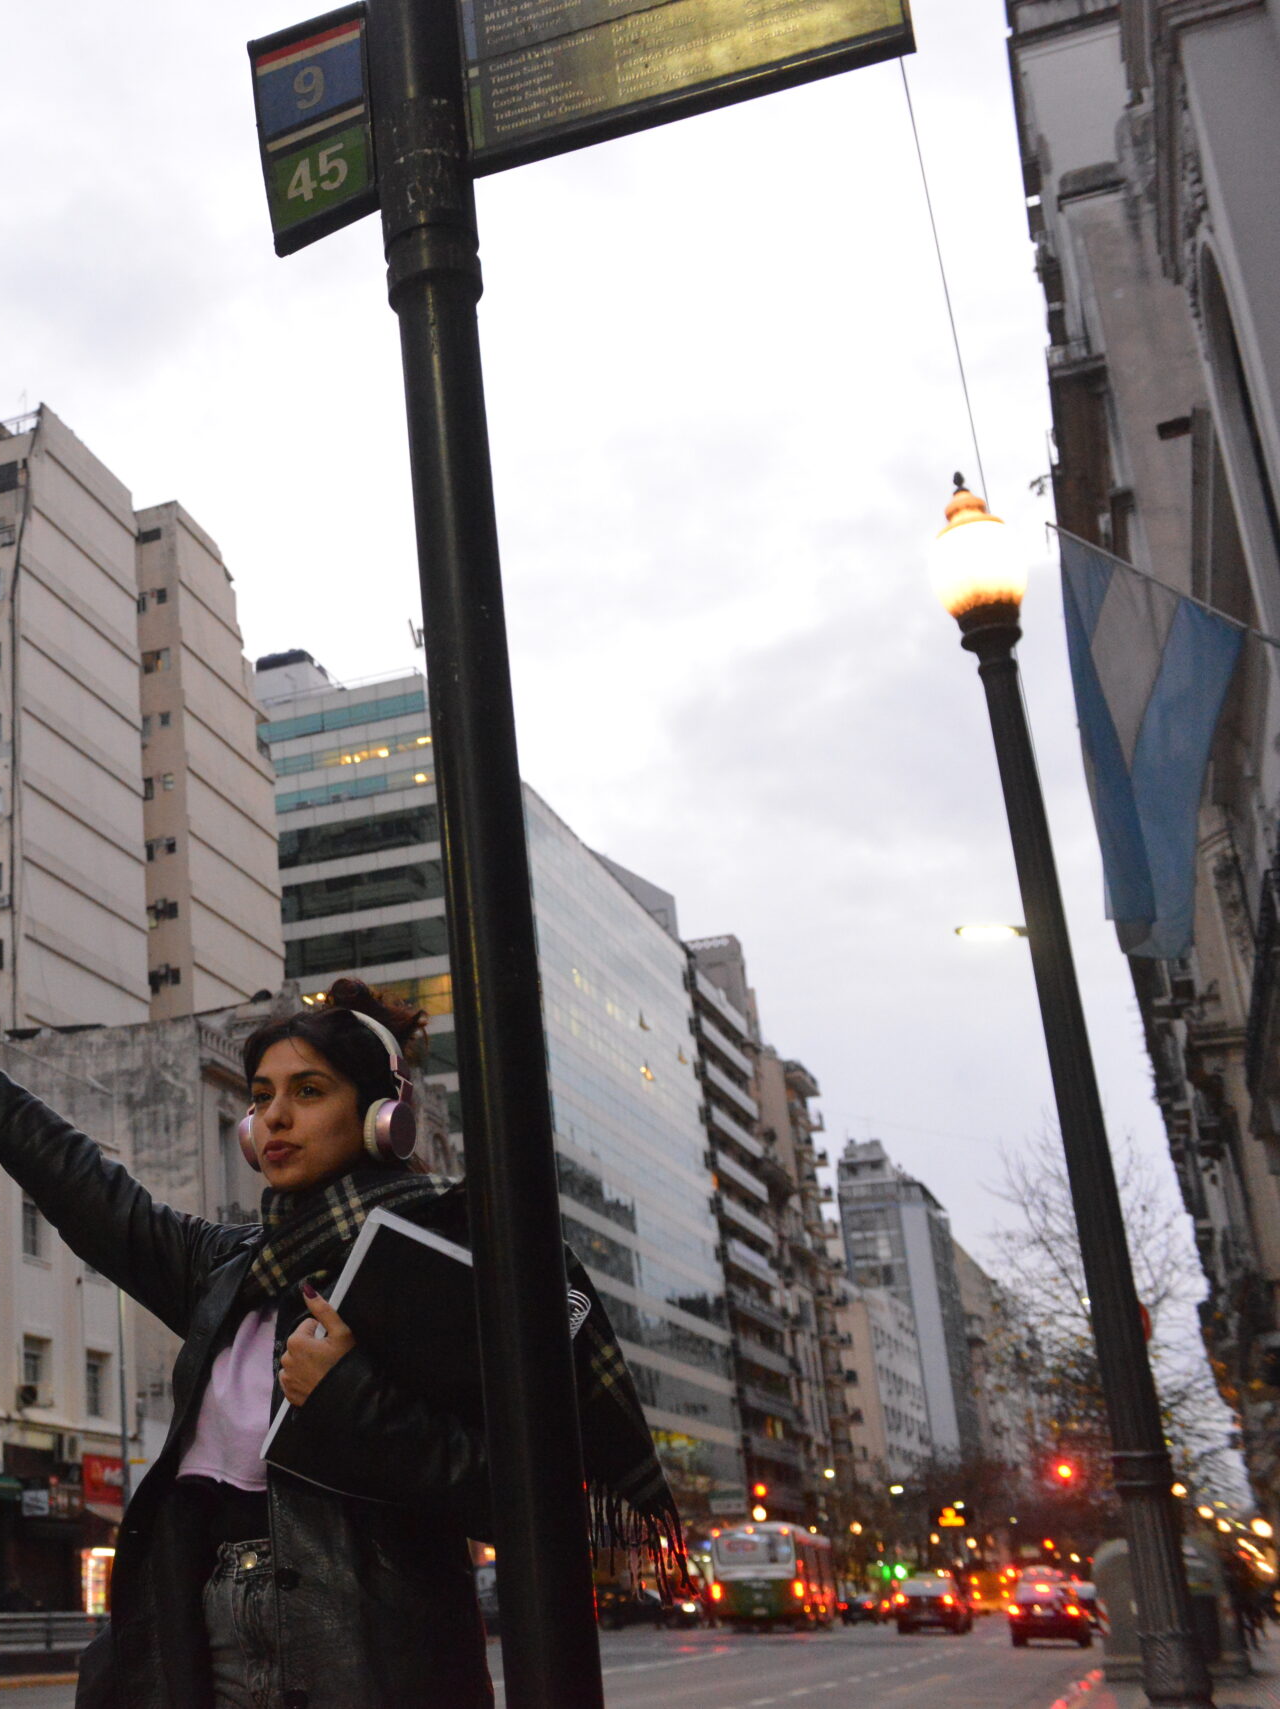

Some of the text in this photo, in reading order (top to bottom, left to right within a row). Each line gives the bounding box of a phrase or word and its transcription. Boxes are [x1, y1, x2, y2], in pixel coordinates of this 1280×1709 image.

[486, 20, 513, 34] Plaza
[489, 35, 595, 72] Ciudad Universitaria
[491, 59, 554, 85] Tierra Santa
[491, 73, 553, 97] Aeroparque
[293, 66, 324, 110] 9
[492, 80, 572, 109] Costa Salguero
[496, 112, 540, 133] Terminal
[543, 108, 557, 120] de
[287, 142, 349, 202] 45
